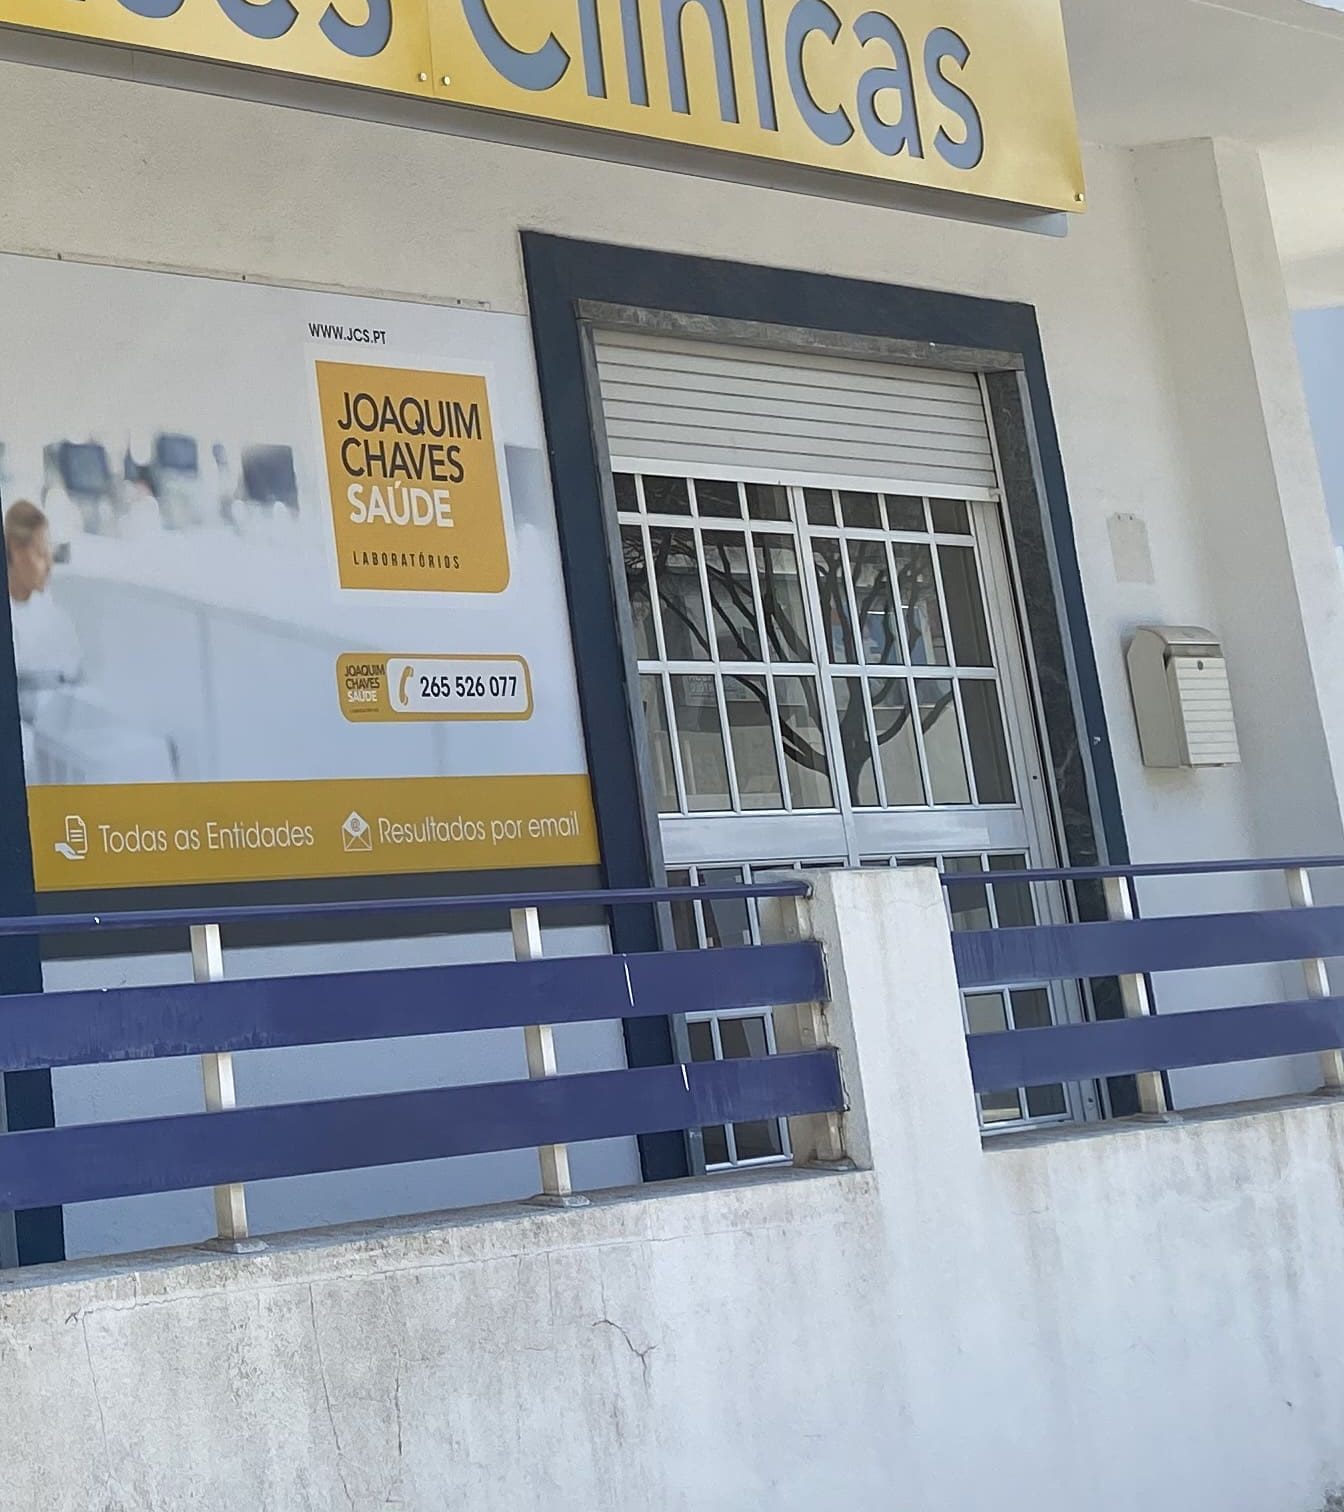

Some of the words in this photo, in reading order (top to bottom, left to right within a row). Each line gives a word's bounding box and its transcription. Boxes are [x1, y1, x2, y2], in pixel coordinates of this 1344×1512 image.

[308, 323, 386, 345] WWW.JCS.PT
[337, 392, 482, 440] JOAQUIM
[341, 438, 465, 483] CHAVES
[347, 480, 454, 528] SAÚDE
[353, 550, 461, 570] LABORATÓRIOS
[344, 664, 385, 677] JOAQUIM
[346, 677, 380, 689] CHAVES
[420, 676, 450, 697] 265
[455, 676, 485, 697] 526
[489, 676, 517, 697] 077
[98, 824, 167, 853] Todas
[174, 829, 200, 850] as
[206, 820, 314, 849] Entidades
[378, 816, 486, 844] Resultados
[491, 819, 522, 845] por
[528, 810, 580, 837] email
